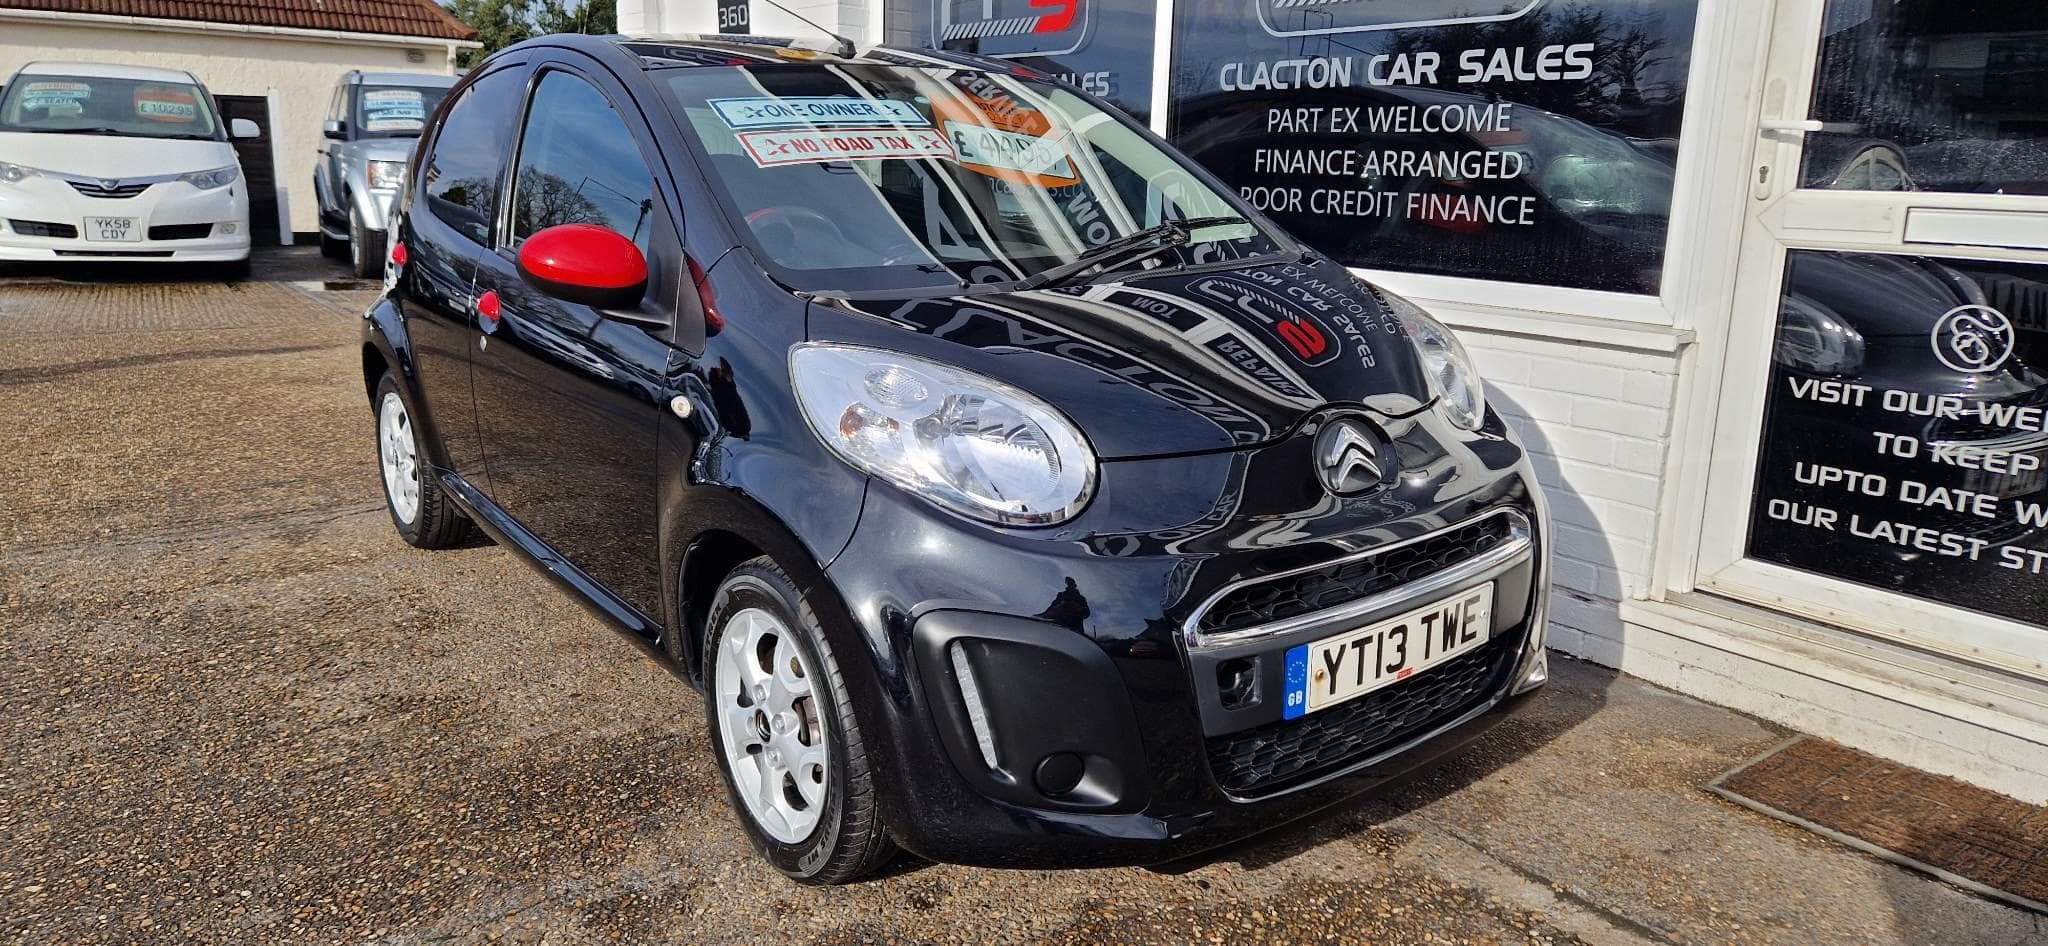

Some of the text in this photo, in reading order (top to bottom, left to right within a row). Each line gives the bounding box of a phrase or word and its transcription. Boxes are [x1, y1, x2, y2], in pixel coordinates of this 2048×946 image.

[719, 4, 748, 28] 360
[1219, 43, 1595, 92] CLACTON CAR SALES
[764, 102, 880, 118] ONE OWNER
[1267, 103, 1512, 135] PART EX WELCOME
[789, 135, 914, 154] NO ROAD TAX
[1254, 148, 1524, 180] FINANCE ARRANGED
[1309, 188, 1397, 218] CREDIT
[1406, 192, 1536, 226] FINANCE
[95, 218, 131, 229] YK58
[101, 229, 127, 240] CDY
[1788, 376, 2048, 433] VISIT OUR WE
[1872, 431, 1919, 459] TO
[1932, 443, 2040, 477] KEEP
[1794, 461, 1888, 498] UPTO
[1898, 479, 1999, 519] DATE
[1767, 498, 1838, 532] OUR
[1849, 515, 1989, 562] LATEST
[1323, 594, 1481, 695] YT13 TWE
[1287, 690, 1303, 707] GB
